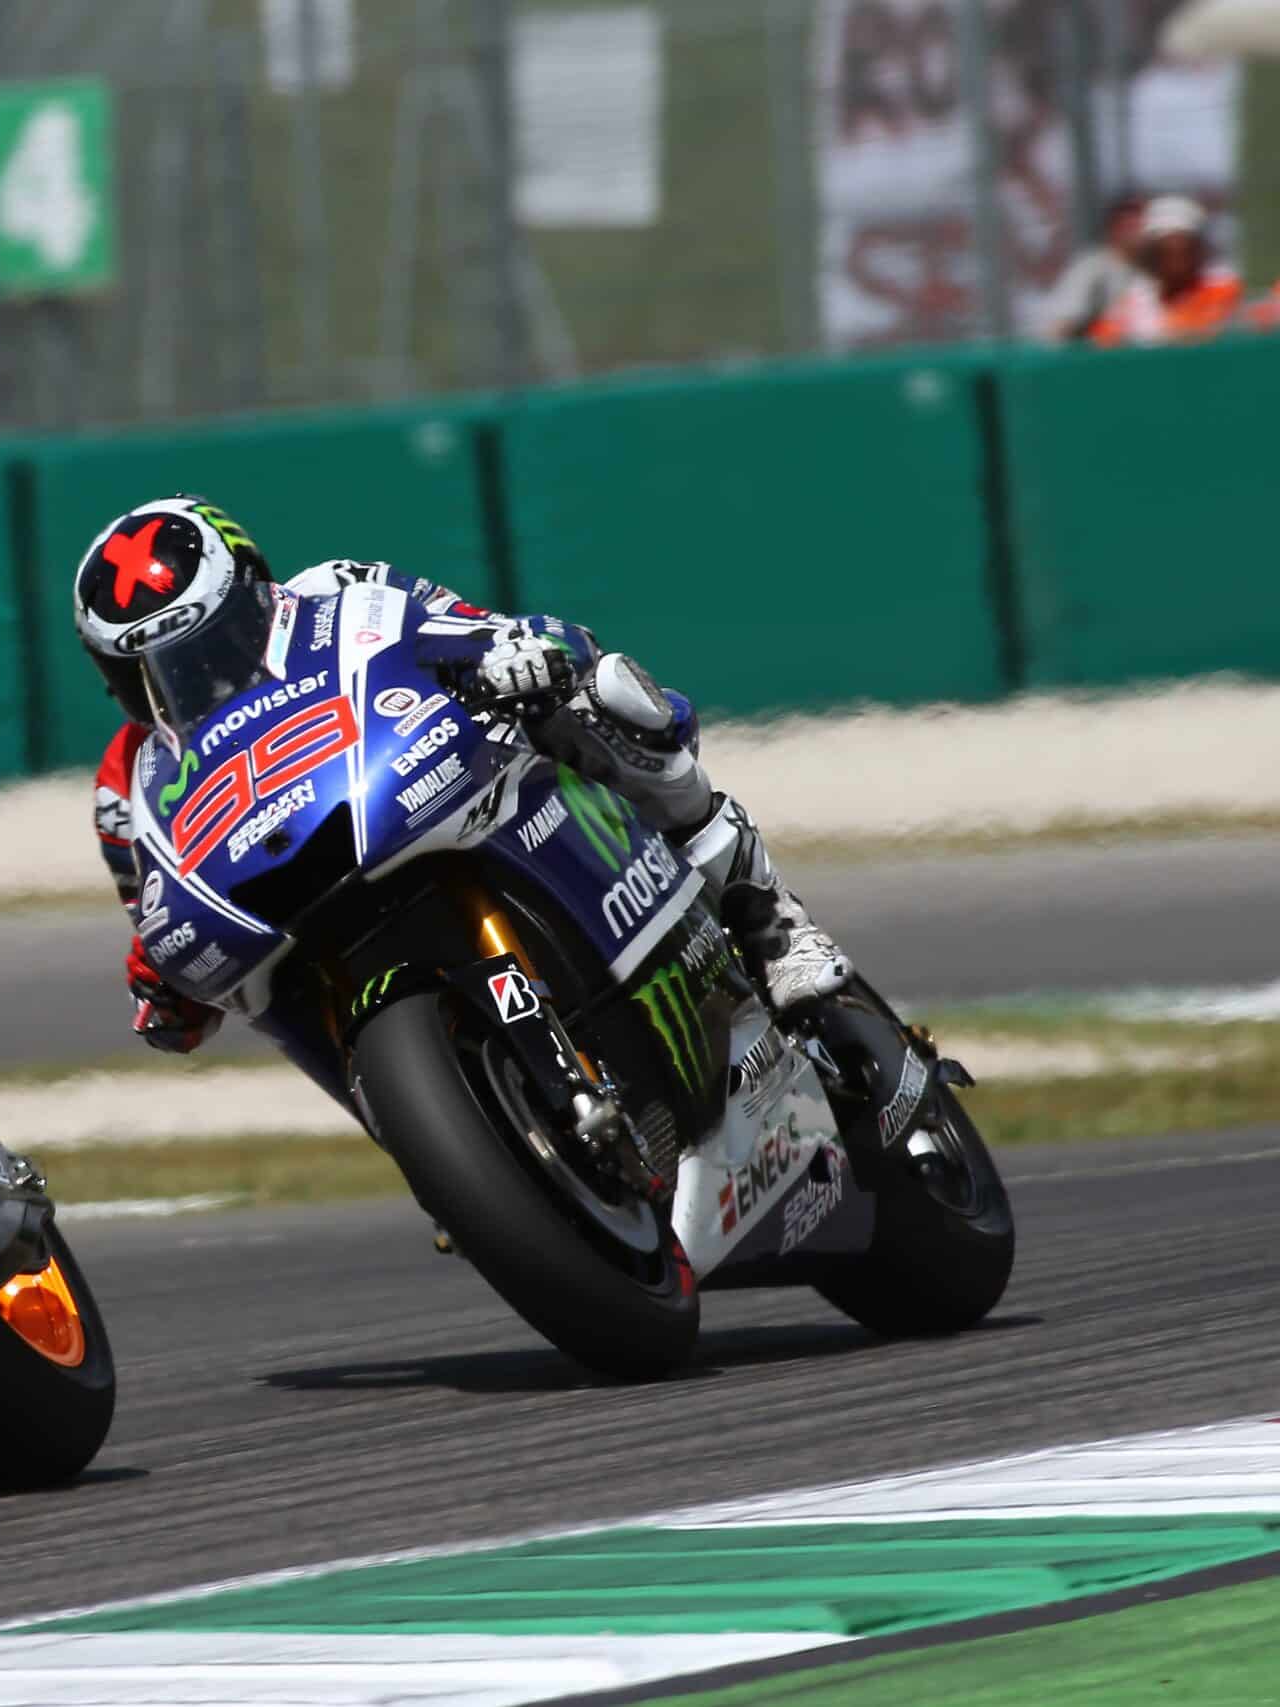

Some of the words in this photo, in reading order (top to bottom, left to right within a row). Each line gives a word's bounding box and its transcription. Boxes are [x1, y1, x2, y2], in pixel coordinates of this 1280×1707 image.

[126, 607, 191, 650] HJC
[200, 670, 329, 757] movistar
[389, 717, 460, 777] ENEOS
[172, 694, 362, 881] 99
[395, 752, 465, 813] YAMALUBE
[516, 795, 569, 853] YAMAHA
